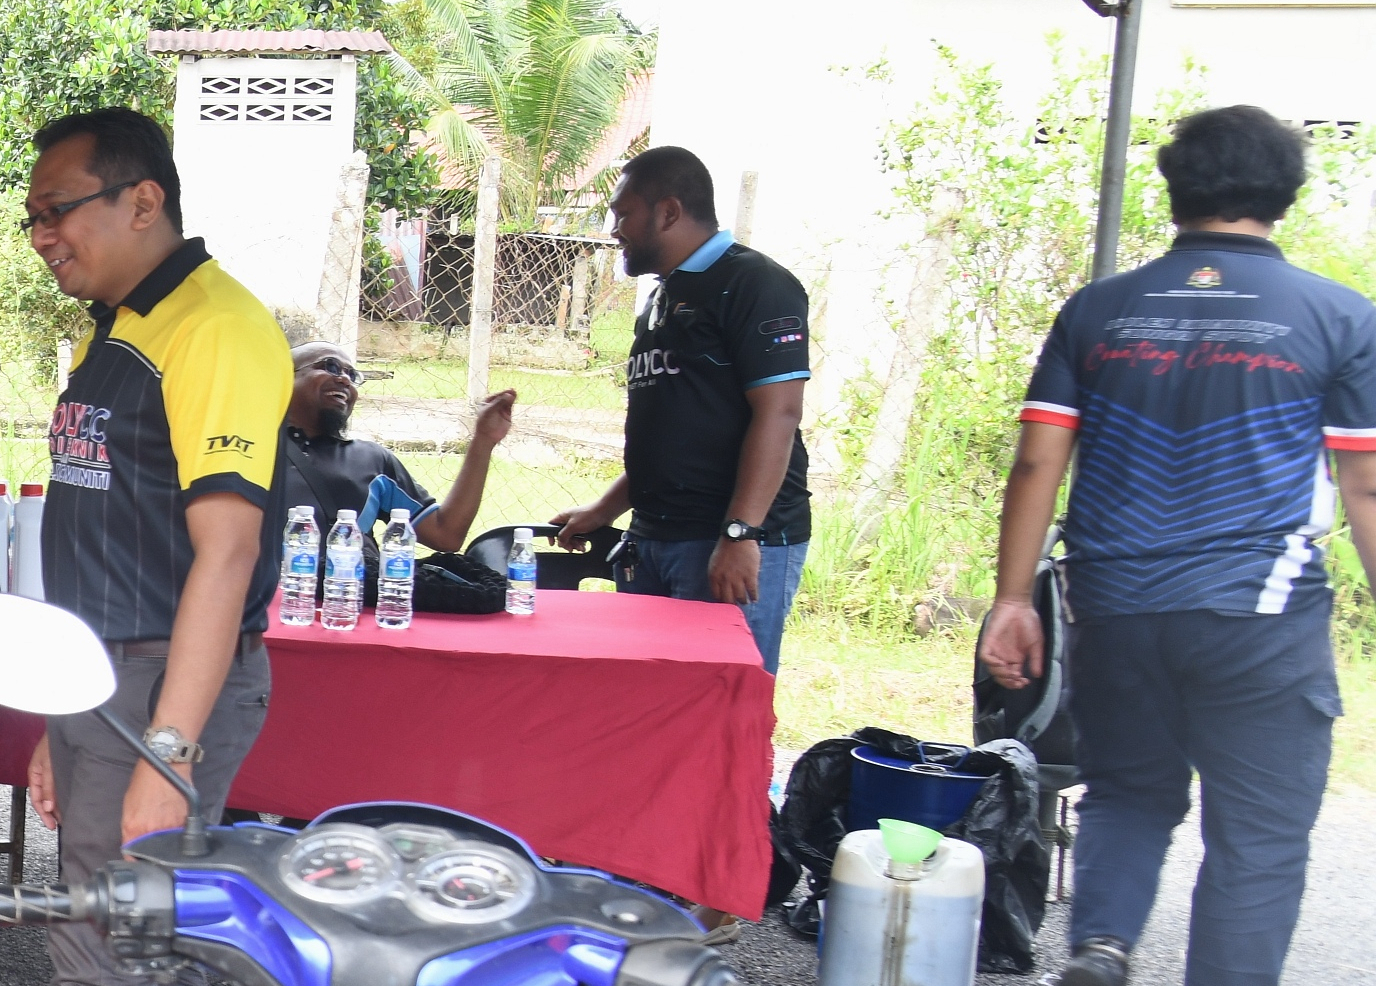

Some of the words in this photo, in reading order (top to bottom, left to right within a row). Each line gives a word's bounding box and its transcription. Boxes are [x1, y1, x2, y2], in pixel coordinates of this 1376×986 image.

[627, 349, 680, 381] OLYCC
[51, 402, 111, 443] OLYCC
[205, 435, 255, 453] TVET
